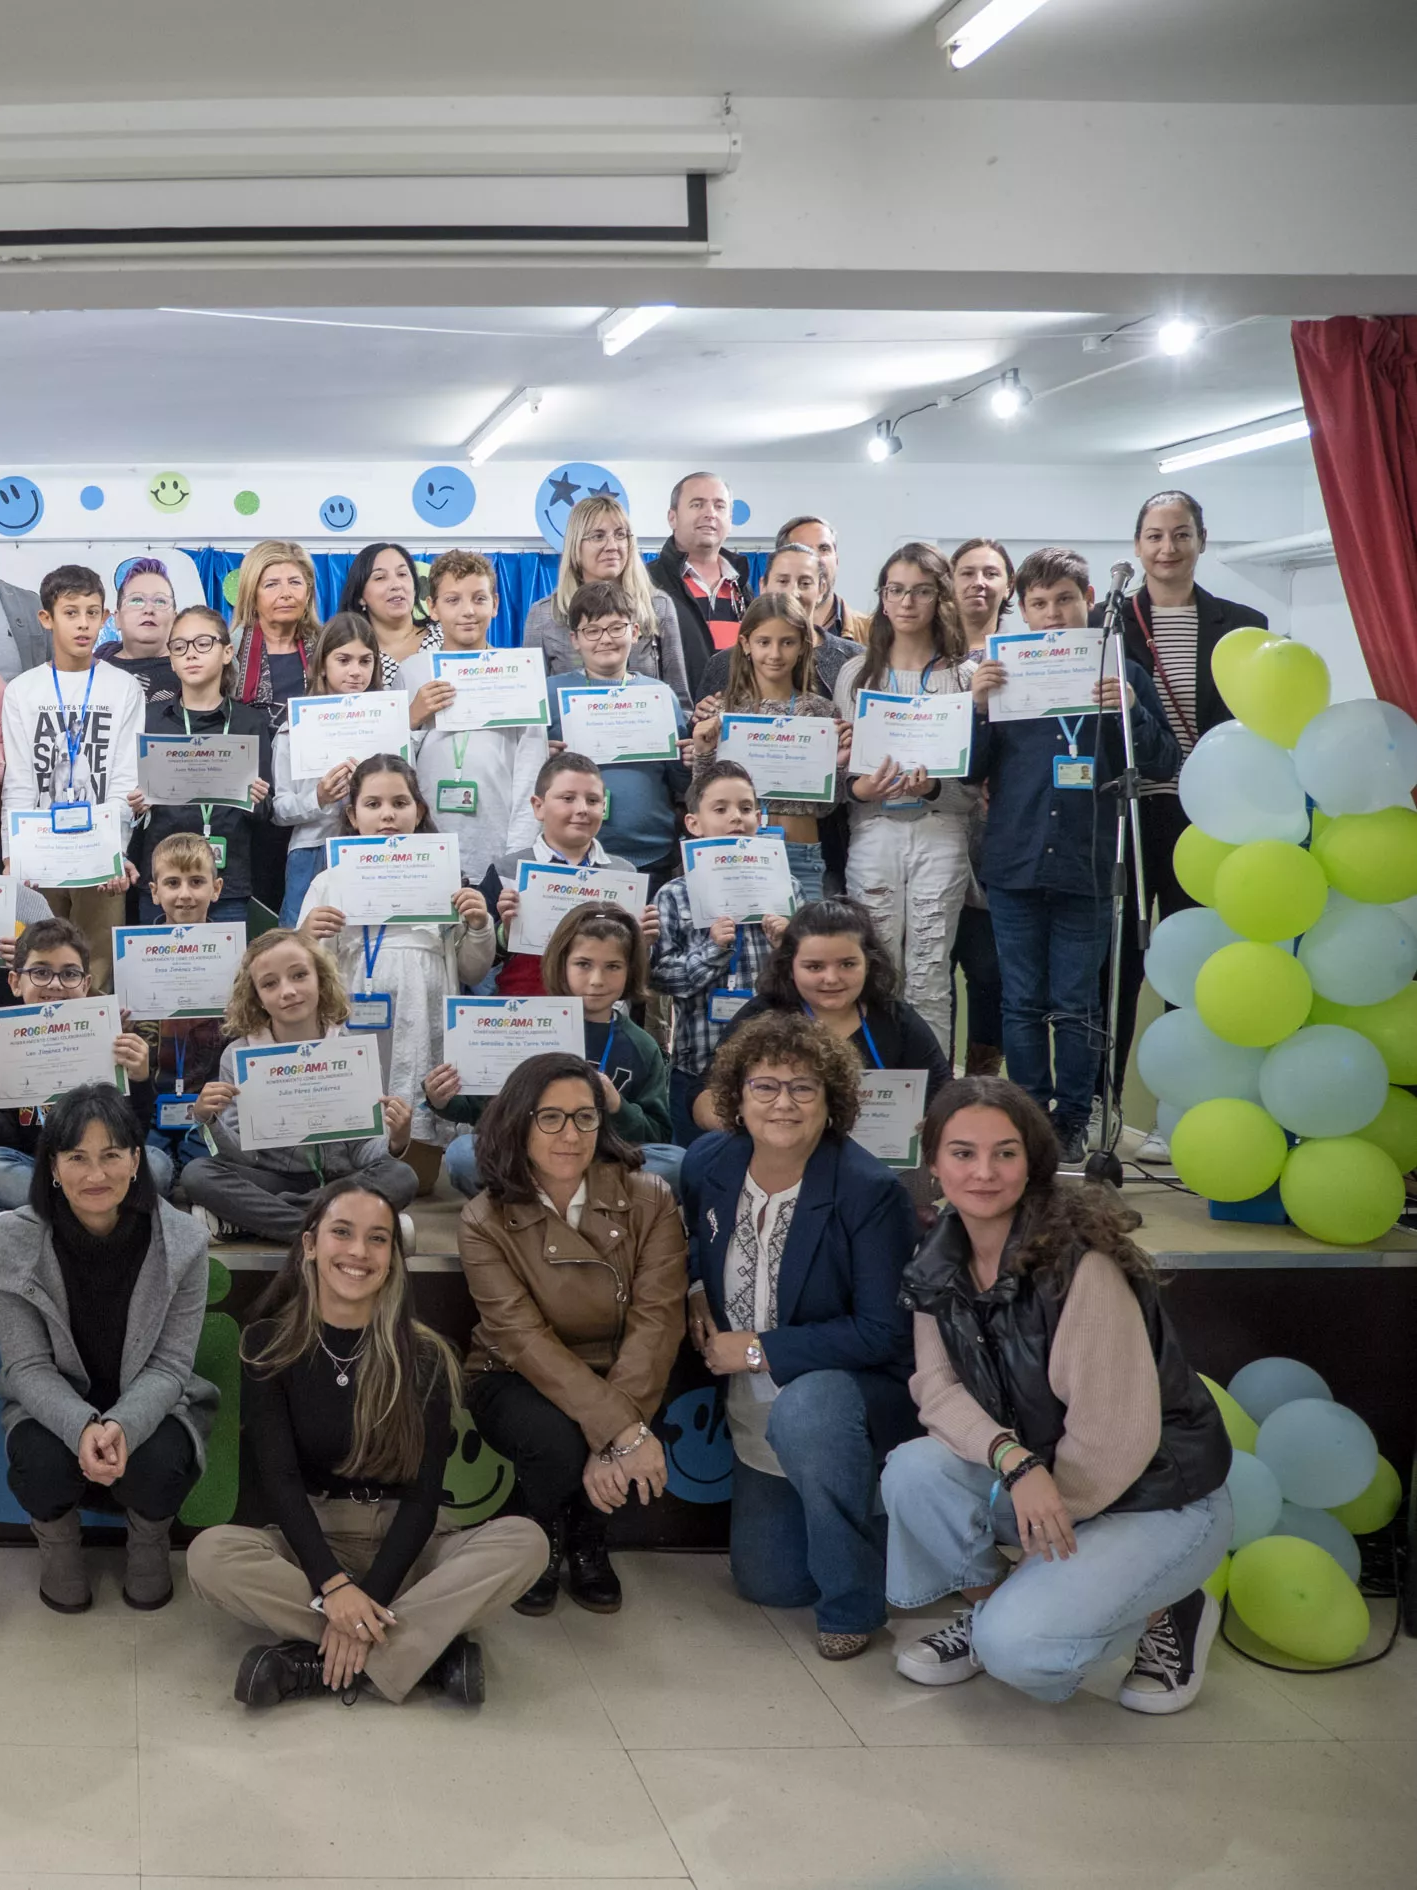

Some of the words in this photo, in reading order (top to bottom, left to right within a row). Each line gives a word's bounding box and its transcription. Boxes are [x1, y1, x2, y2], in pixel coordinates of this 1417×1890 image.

[1018, 648, 1071, 659] PROGRAMA
[1074, 647, 1089, 655] TEI
[458, 666, 503, 676] PROGRAMA
[506, 665, 518, 673] TEI
[587, 702, 632, 711] PROGRAMA
[635, 701, 647, 709] TEI
[318, 710, 365, 720] PROGRAMA
[369, 709, 381, 717] TEI
[884, 711, 933, 721] PROGRAMA
[935, 712, 948, 720] TEI
[34, 711, 112, 744] AWE
[747, 733, 795, 742] PROGRAMA
[798, 735, 812, 743] TEI
[34, 743, 109, 774] SE
[360, 853, 413, 863] PROGRAMA
[416, 853, 430, 862] TEI
[714, 855, 758, 864] PROGRAMA
[759, 856, 769, 865] TEI
[547, 884, 600, 897] PROGRAMA
[603, 890, 618, 899] TEI
[145, 945, 199, 955] PROGRAMA
[202, 944, 216, 952] TEI
[477, 1018, 533, 1027] PROGRAMA
[537, 1018, 552, 1027] TEI
[14, 1022, 71, 1038] PROGRAMA
[74, 1021, 89, 1031] TEI
[270, 1062, 328, 1076] PROGRAMA
[331, 1060, 347, 1070] TEI
[877, 1090, 893, 1099] TEI
